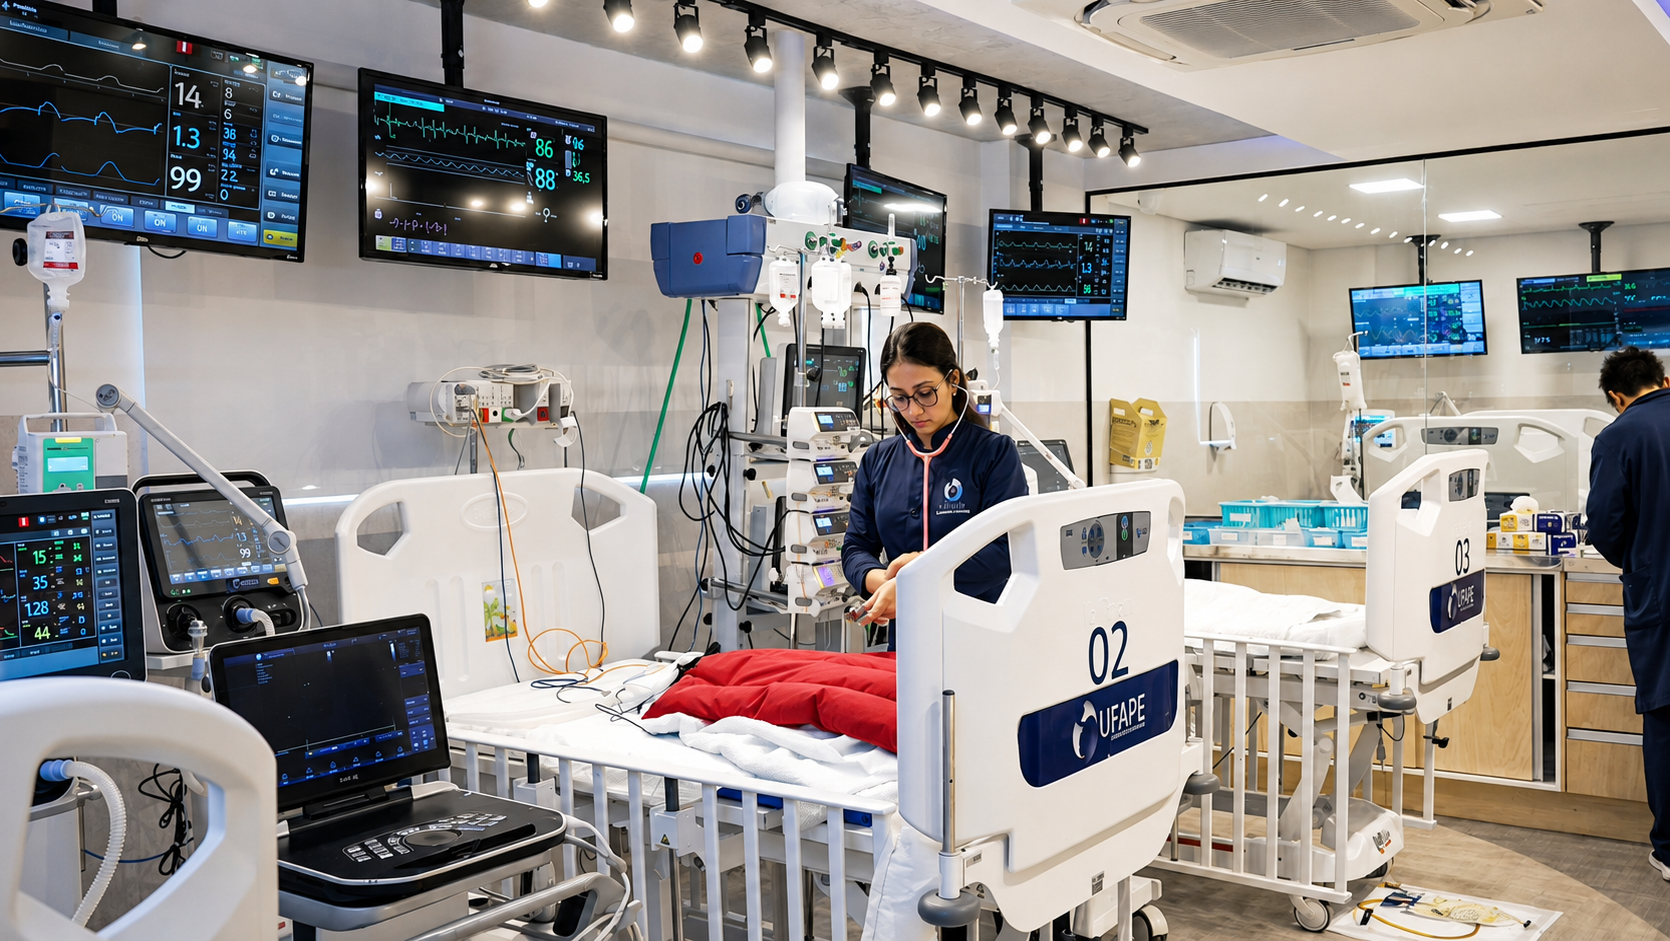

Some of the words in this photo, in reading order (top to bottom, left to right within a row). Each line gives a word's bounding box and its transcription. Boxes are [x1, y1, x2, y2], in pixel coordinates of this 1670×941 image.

[175, 82, 202, 108] 14
[225, 87, 233, 99] 8
[224, 108, 232, 119] 6
[173, 125, 201, 149] 1.3
[535, 138, 554, 159] 86
[170, 166, 202, 192] 99
[221, 169, 239, 182] 22
[535, 167, 556, 191] 88
[112, 213, 124, 222] ON
[154, 218, 166, 227] ON
[197, 224, 208, 233] ON
[32, 549, 47, 565] 15
[239, 548, 251, 559] 99
[1455, 538, 1470, 576] 03
[32, 575, 48, 590] 35
[24, 600, 49, 617] 128
[34, 625, 51, 640] 44
[1088, 620, 1129, 686] 02
[1100, 693, 1145, 738] UFAPE
